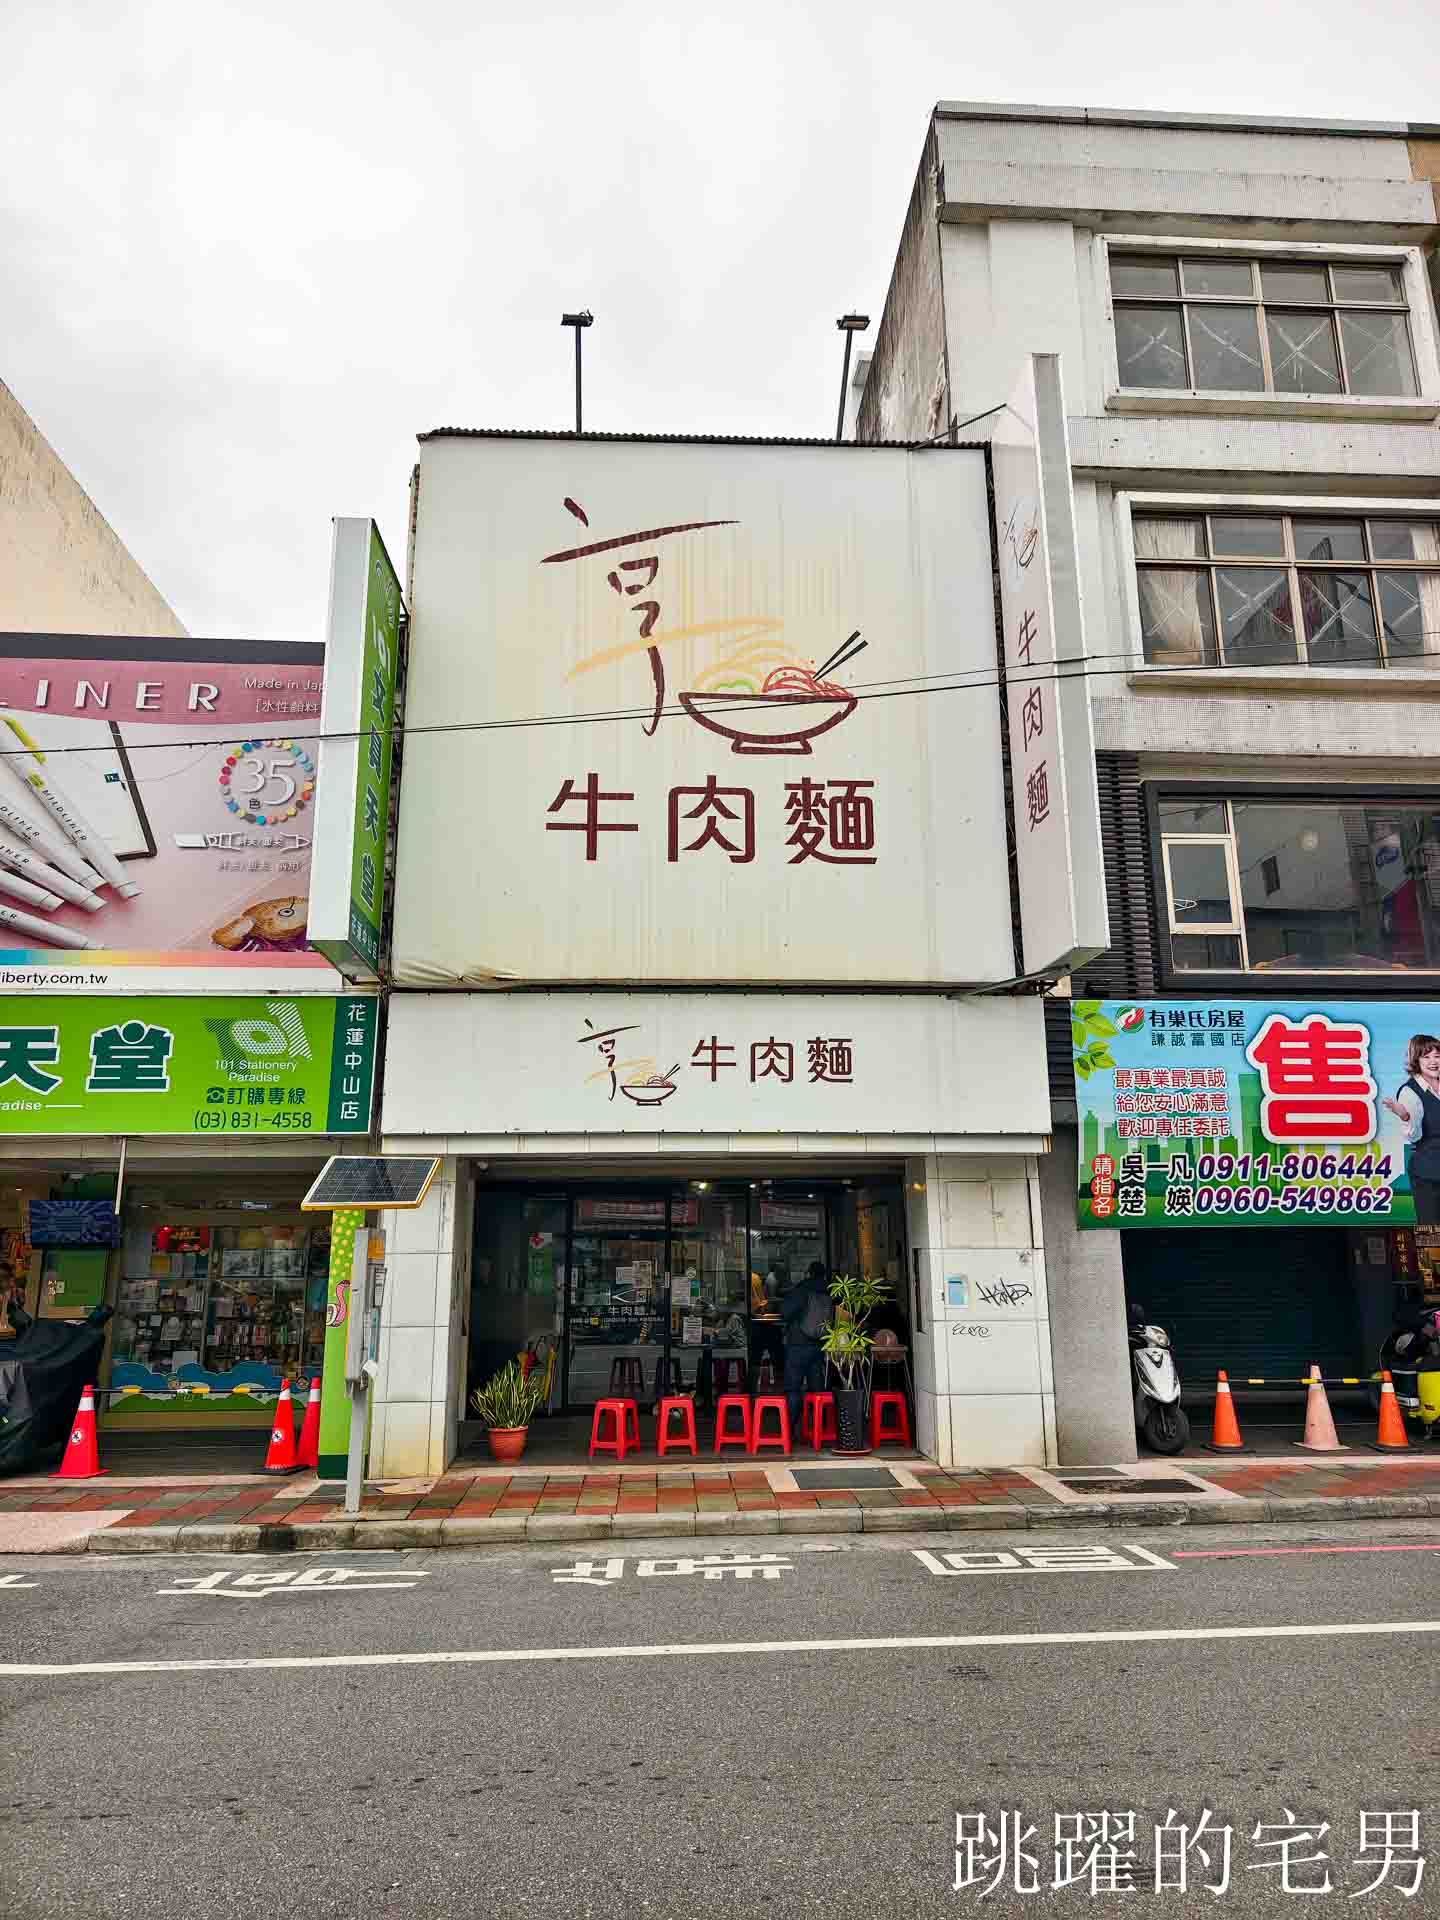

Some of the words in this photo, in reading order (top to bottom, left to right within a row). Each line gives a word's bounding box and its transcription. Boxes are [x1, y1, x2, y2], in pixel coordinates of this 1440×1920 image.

[244, 677, 281, 689] Made
[287, 679, 299, 689] in
[0, 679, 220, 712] INER
[1018, 608, 1050, 833] 牛肉麵
[240, 759, 297, 806] 35
[545, 771, 877, 865] 牛肉麵
[0, 971, 108, 986] iberty.com.tw
[1148, 1009, 1246, 1028] 有巢氏房屋
[1151, 1032, 1246, 1047] 謙誠富國店
[239, 1060, 297, 1072] Stationery
[340, 1003, 366, 1120] 花蓮中山店
[690, 1035, 854, 1083] 牛肉麵
[229, 1072, 280, 1082] Paradise
[1114, 1069, 1226, 1089] 最專業最真誠
[1250, 1018, 1374, 1140] 售
[227, 1087, 306, 1105] 訂購專線
[1116, 1093, 1228, 1113] 給您安心滿意
[1118, 1117, 1230, 1137] 歡迎專任委託
[1121, 1154, 1193, 1180] 吳一凡
[1198, 1154, 1392, 1180] 0911-806444
[1094, 1157, 1112, 1214] 請指名
[1196, 1187, 1392, 1212] 0960-549862
